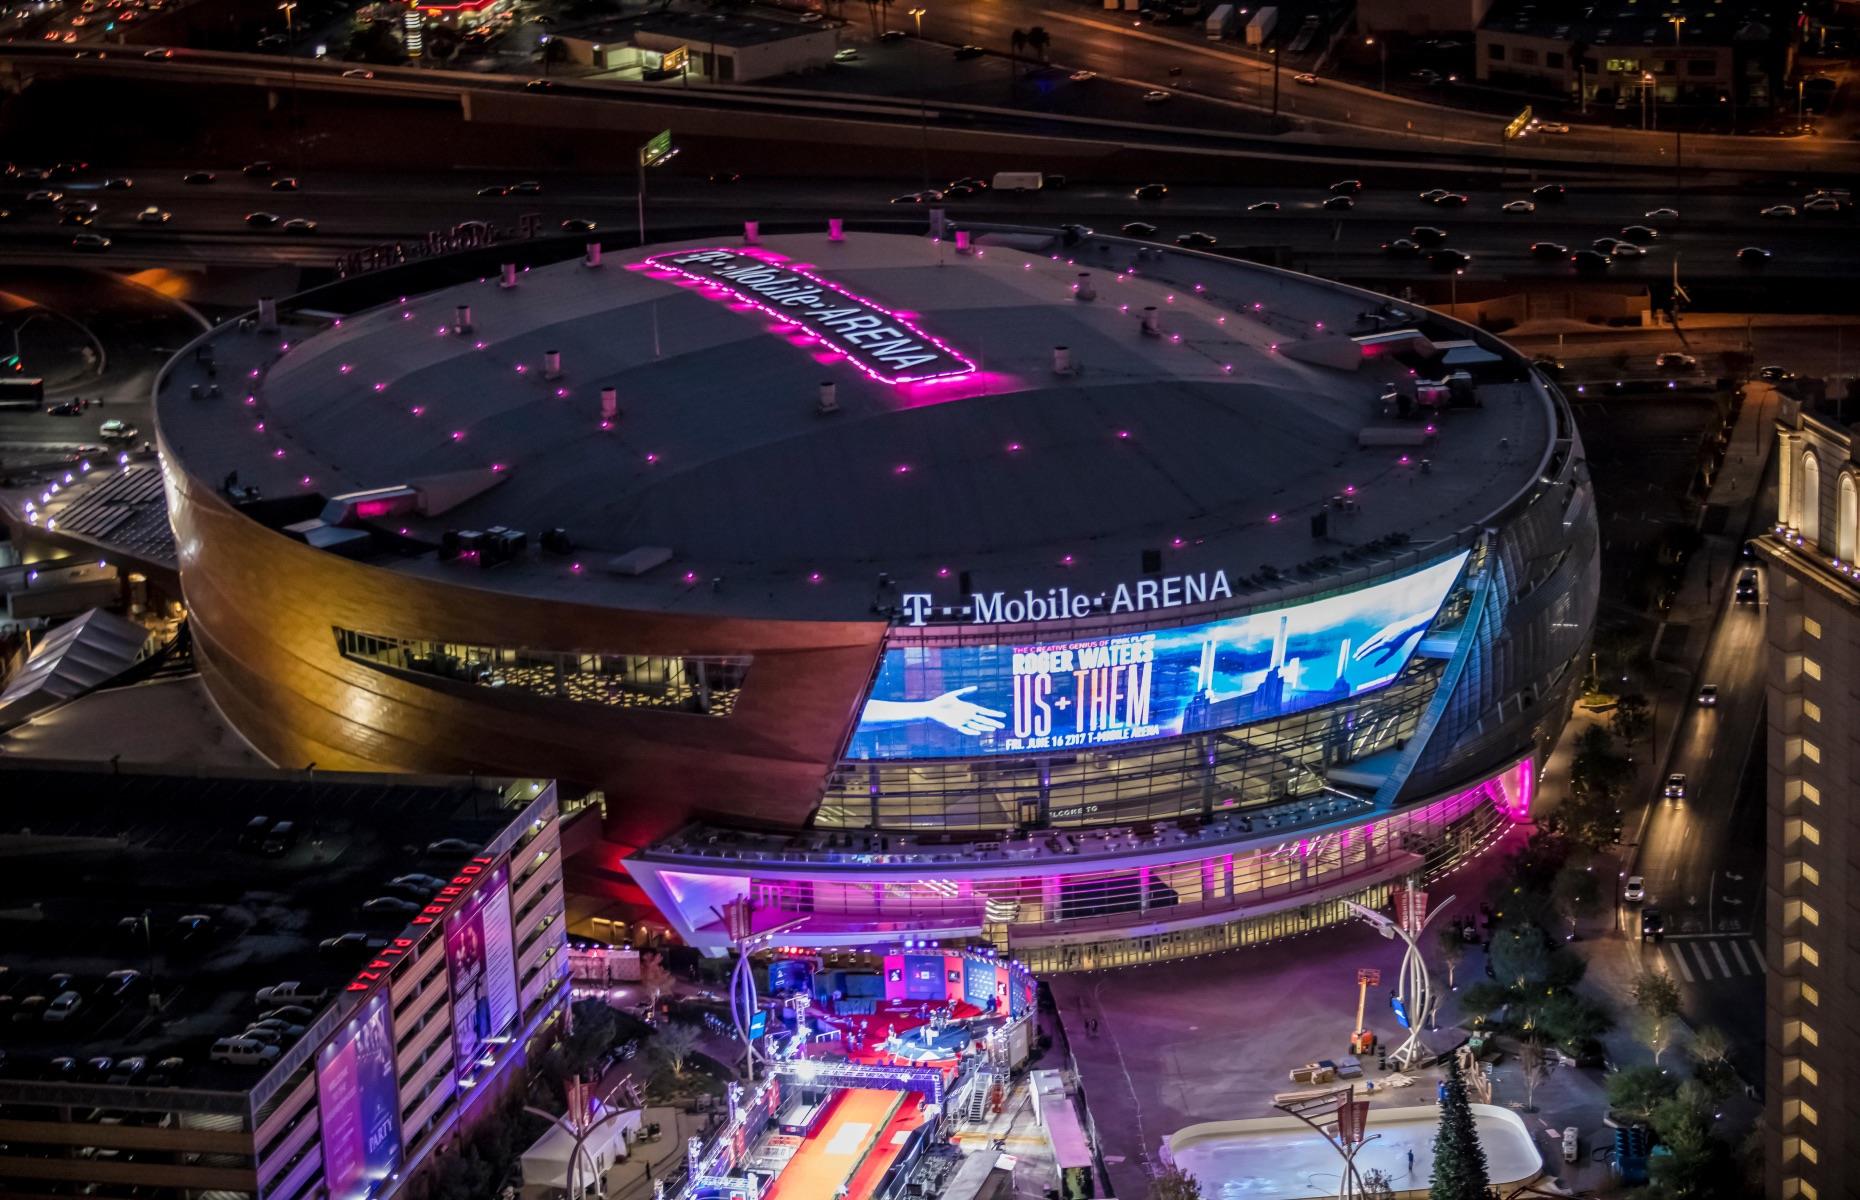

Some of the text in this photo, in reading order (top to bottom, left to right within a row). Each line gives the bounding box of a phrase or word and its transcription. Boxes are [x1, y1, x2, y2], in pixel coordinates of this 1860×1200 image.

[805, 307, 938, 370] ARENA
[1110, 570, 1232, 614] ARENA
[1013, 641, 1154, 675] ROGER WATERS
[1030, 643, 1067, 653] CREATIVE
[1069, 641, 1097, 650] GENIUS
[1099, 639, 1109, 648] OF
[1073, 664, 1152, 733] THEM
[1052, 736, 1063, 747] 16
[346, 857, 492, 991] TOSHIBA PLAZA
[369, 1114, 393, 1153] PARTY
